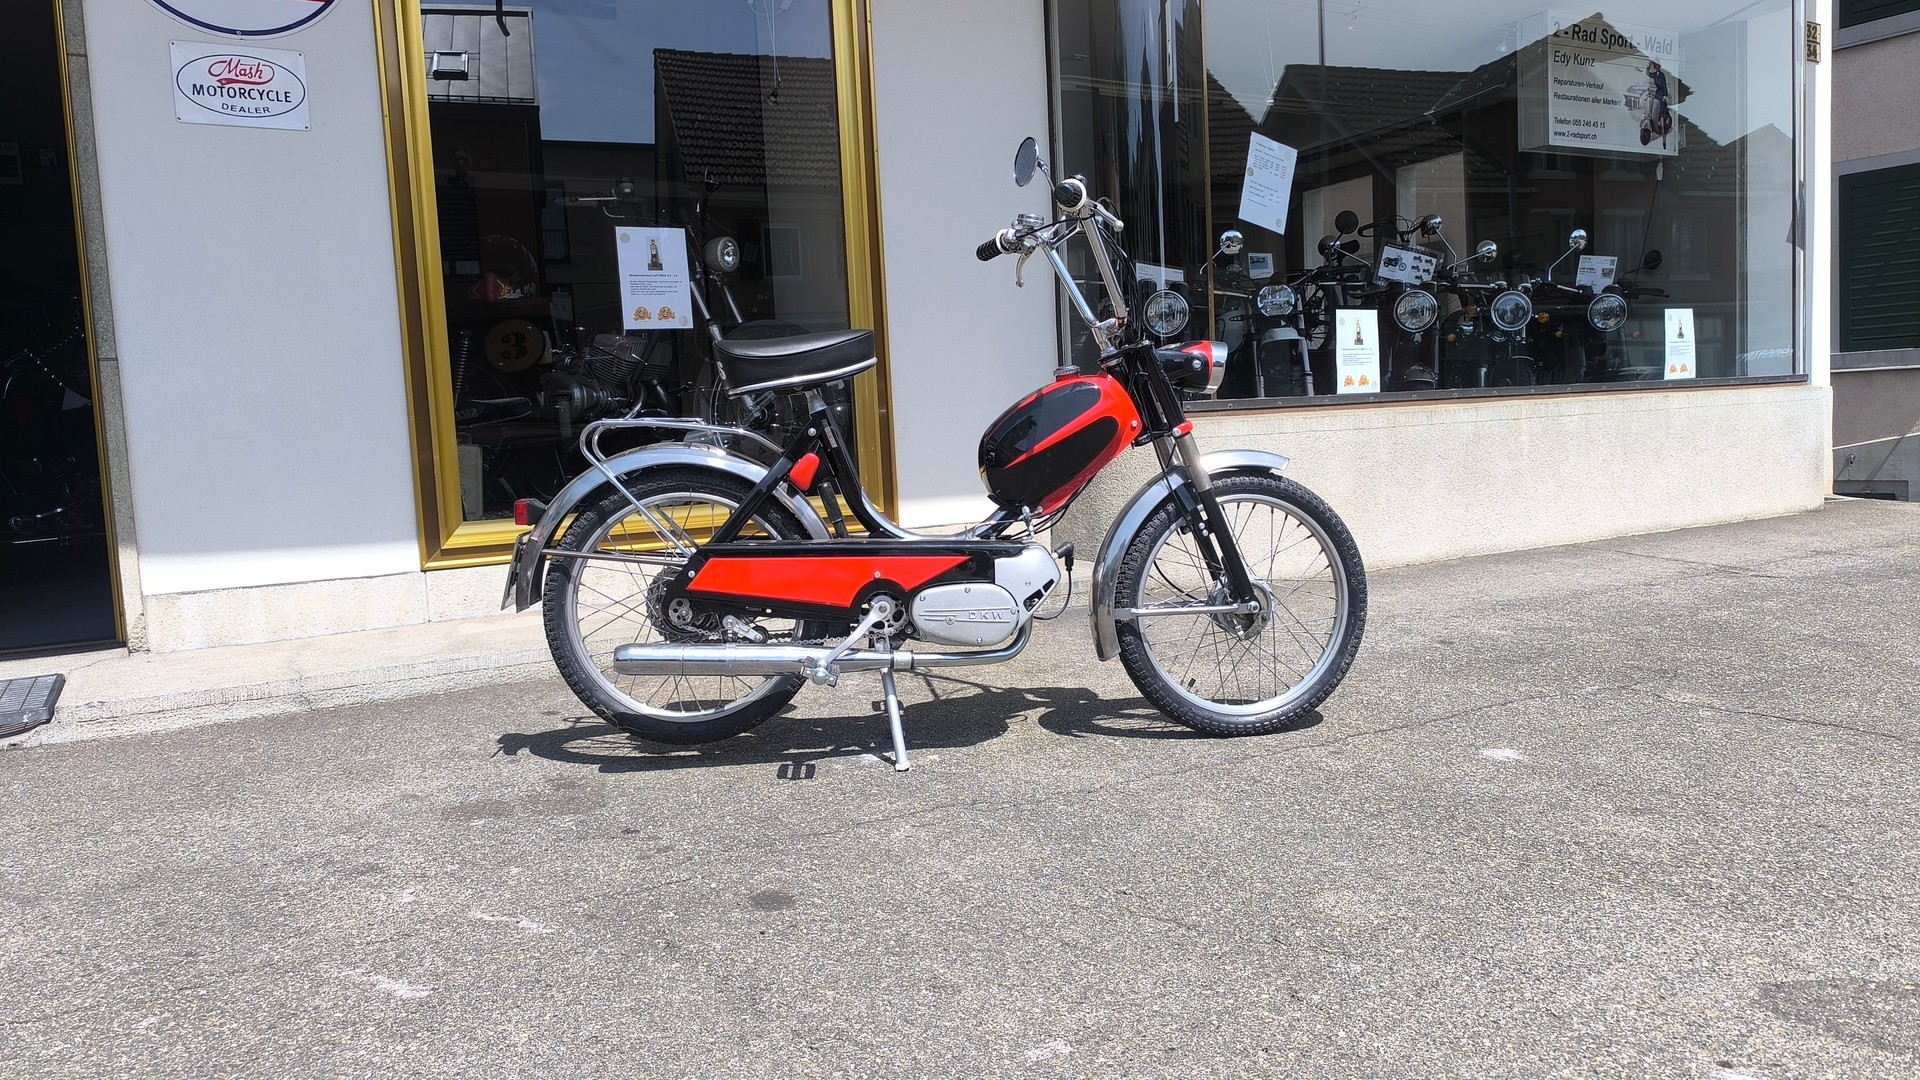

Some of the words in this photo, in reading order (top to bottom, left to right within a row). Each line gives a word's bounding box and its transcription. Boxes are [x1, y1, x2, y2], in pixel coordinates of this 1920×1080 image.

[1571, 23, 1598, 43] Rad
[1600, 28, 1635, 50] Sport
[1644, 34, 1674, 55] Wald
[1806, 24, 1817, 39] 32
[1806, 43, 1817, 59] 34
[1553, 50, 1571, 66] Edy
[1573, 52, 1596, 68] Kunz
[208, 58, 275, 85] Mash
[1553, 77, 1604, 90] Reparaturen-Verkauf
[192, 83, 292, 103] MOTORCYCLE
[1553, 92, 1590, 103] Restaurationen
[1591, 96, 1602, 104] aller
[221, 103, 271, 114] DEALER
[1554, 117, 1571, 126] Telefon
[1572, 118, 1581, 127] 055
[968, 611, 1005, 620] DKW
